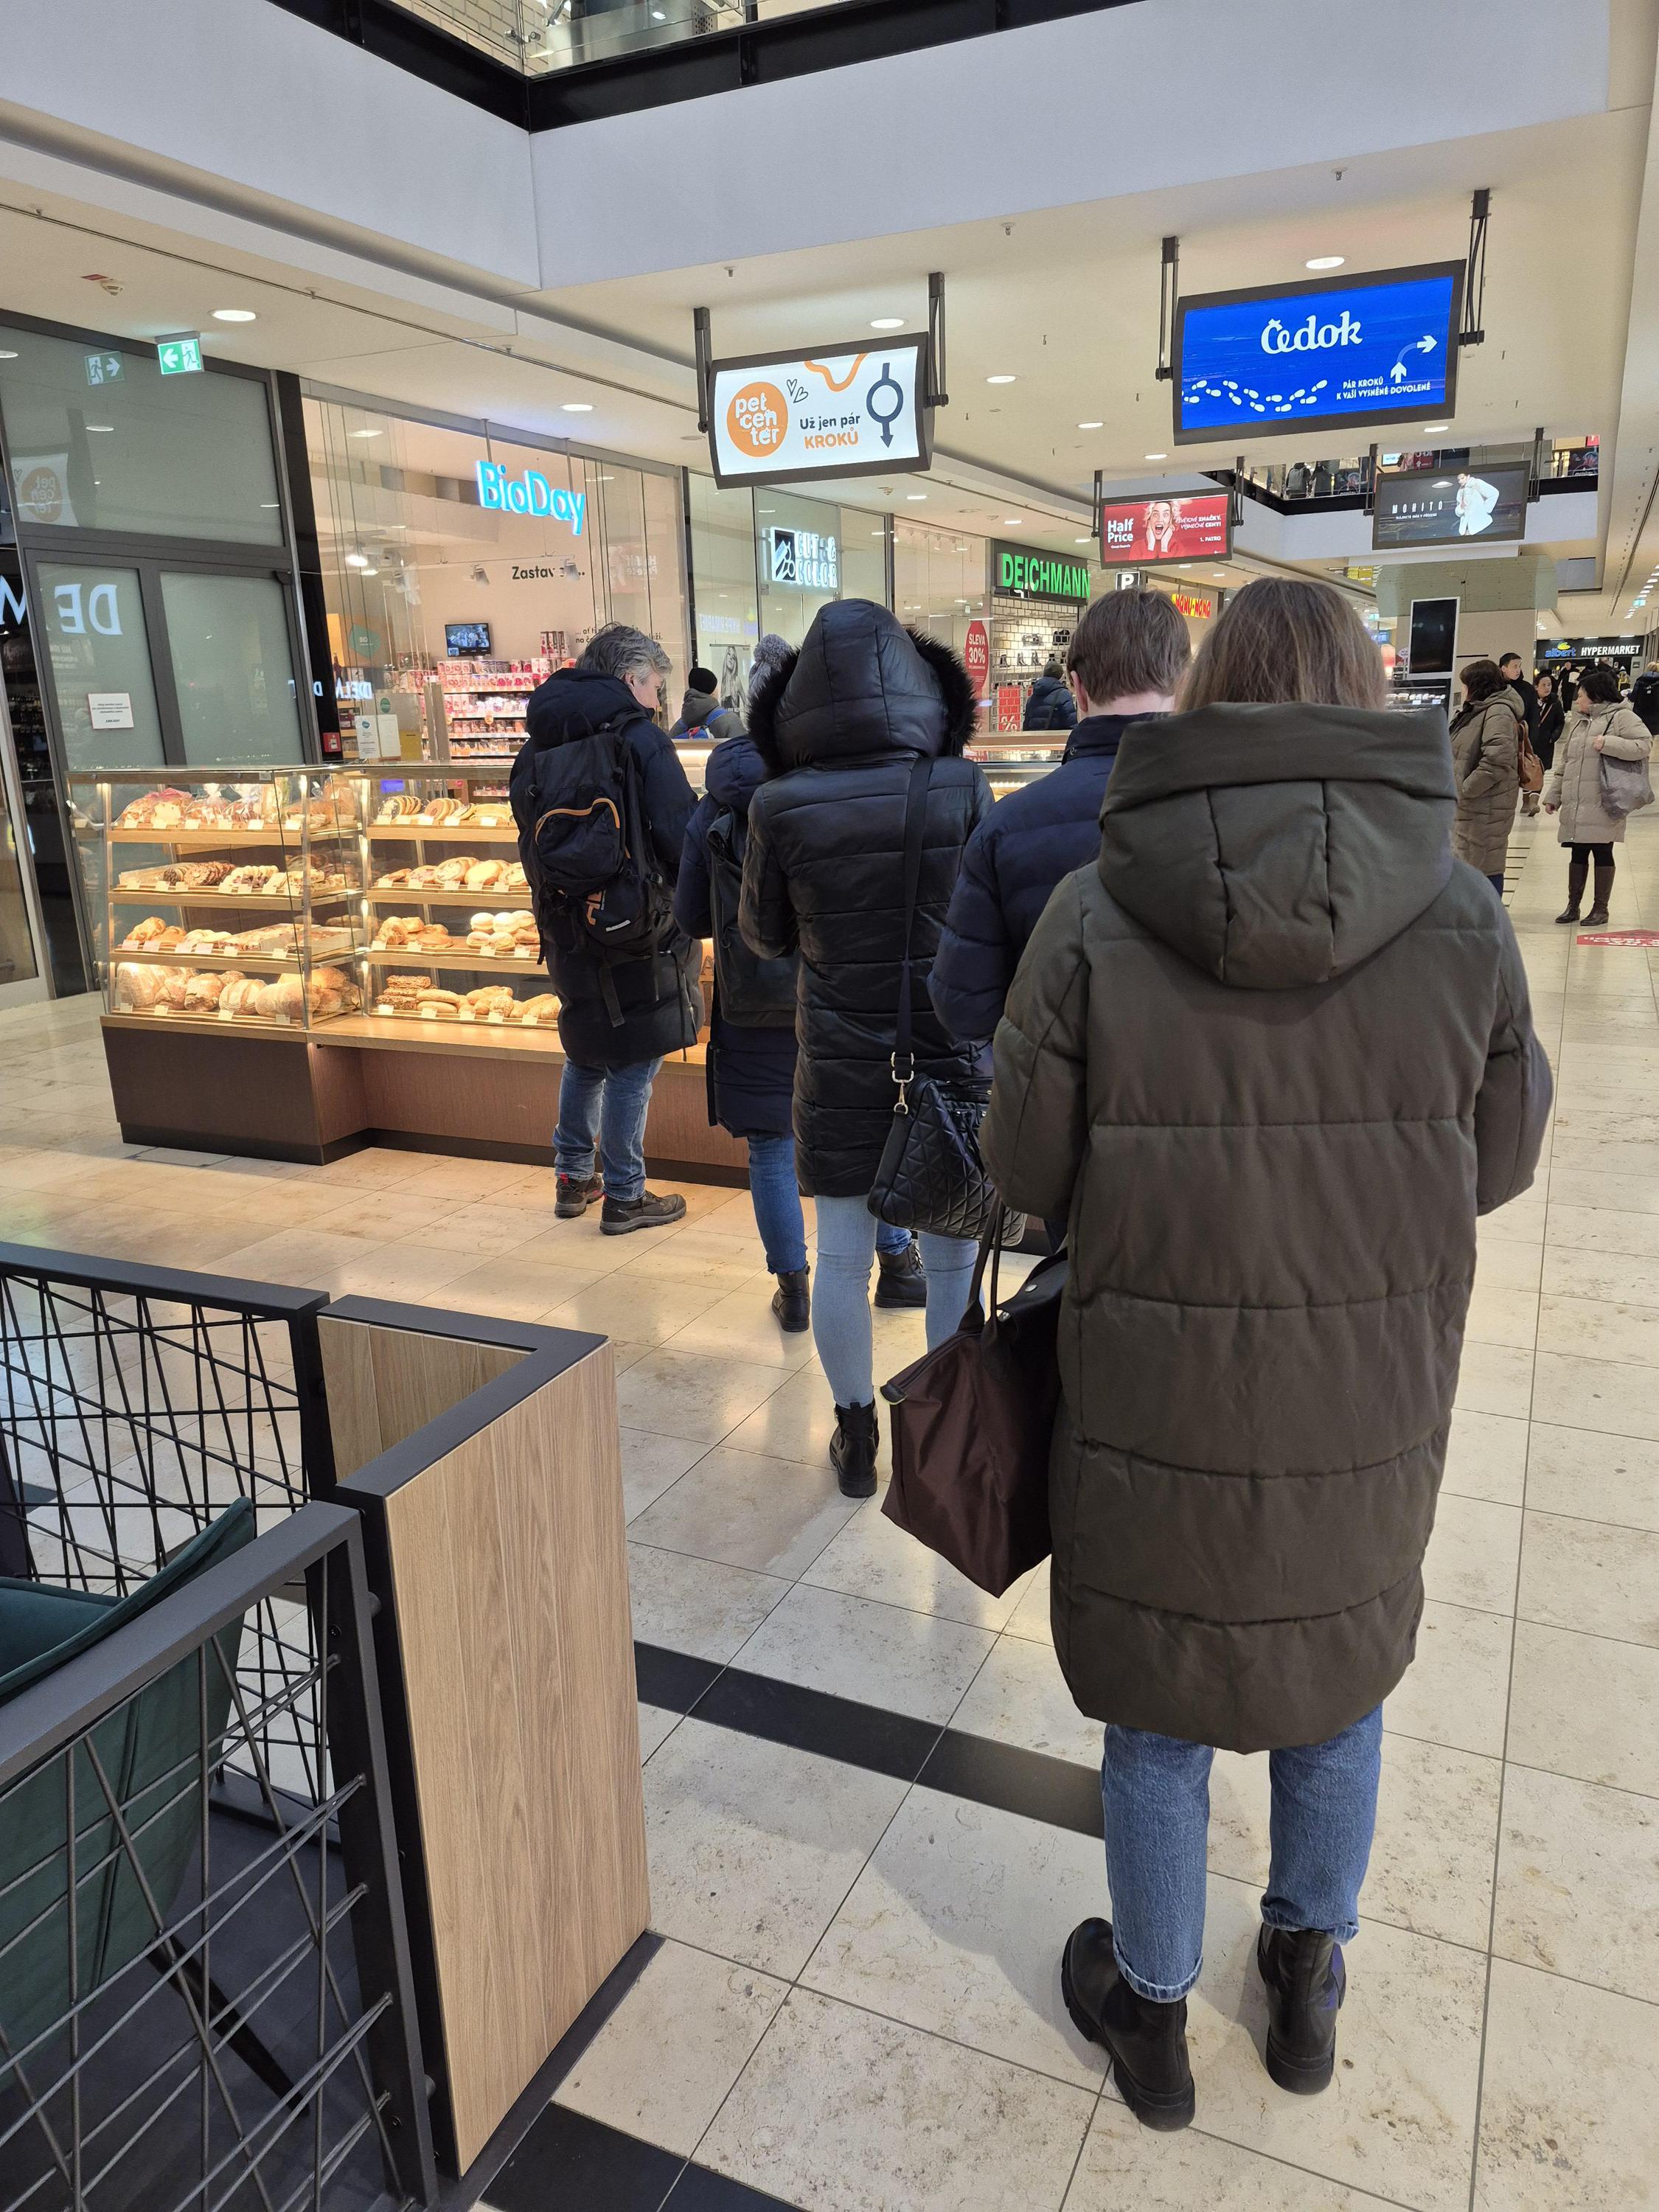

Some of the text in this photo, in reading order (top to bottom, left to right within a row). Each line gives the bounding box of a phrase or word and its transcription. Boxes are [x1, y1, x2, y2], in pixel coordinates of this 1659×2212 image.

[1260, 310, 1363, 354] Čedok
[1336, 381, 1431, 400] K VAŠÍ VYSNĚNÉ DOVOLENÉ
[1343, 376, 1384, 389] PÁR KROKŮ
[735, 392, 768, 419] pet
[740, 409, 777, 429] cen
[799, 412, 860, 431] Už jen pár
[751, 426, 779, 446] ter
[804, 427, 859, 449] KROKŮ
[476, 460, 585, 536] BioDay
[1107, 518, 1134, 532] Half
[796, 530, 819, 559] CUT
[1107, 532, 1133, 543] Price
[796, 558, 838, 588] COLOR
[1001, 552, 1091, 599] DEICHMANN
[1121, 574, 1135, 590] P
[968, 633, 985, 646] SLEVA
[968, 647, 986, 664] 30%
[1545, 645, 1641, 658] albert HYPERMARKET
